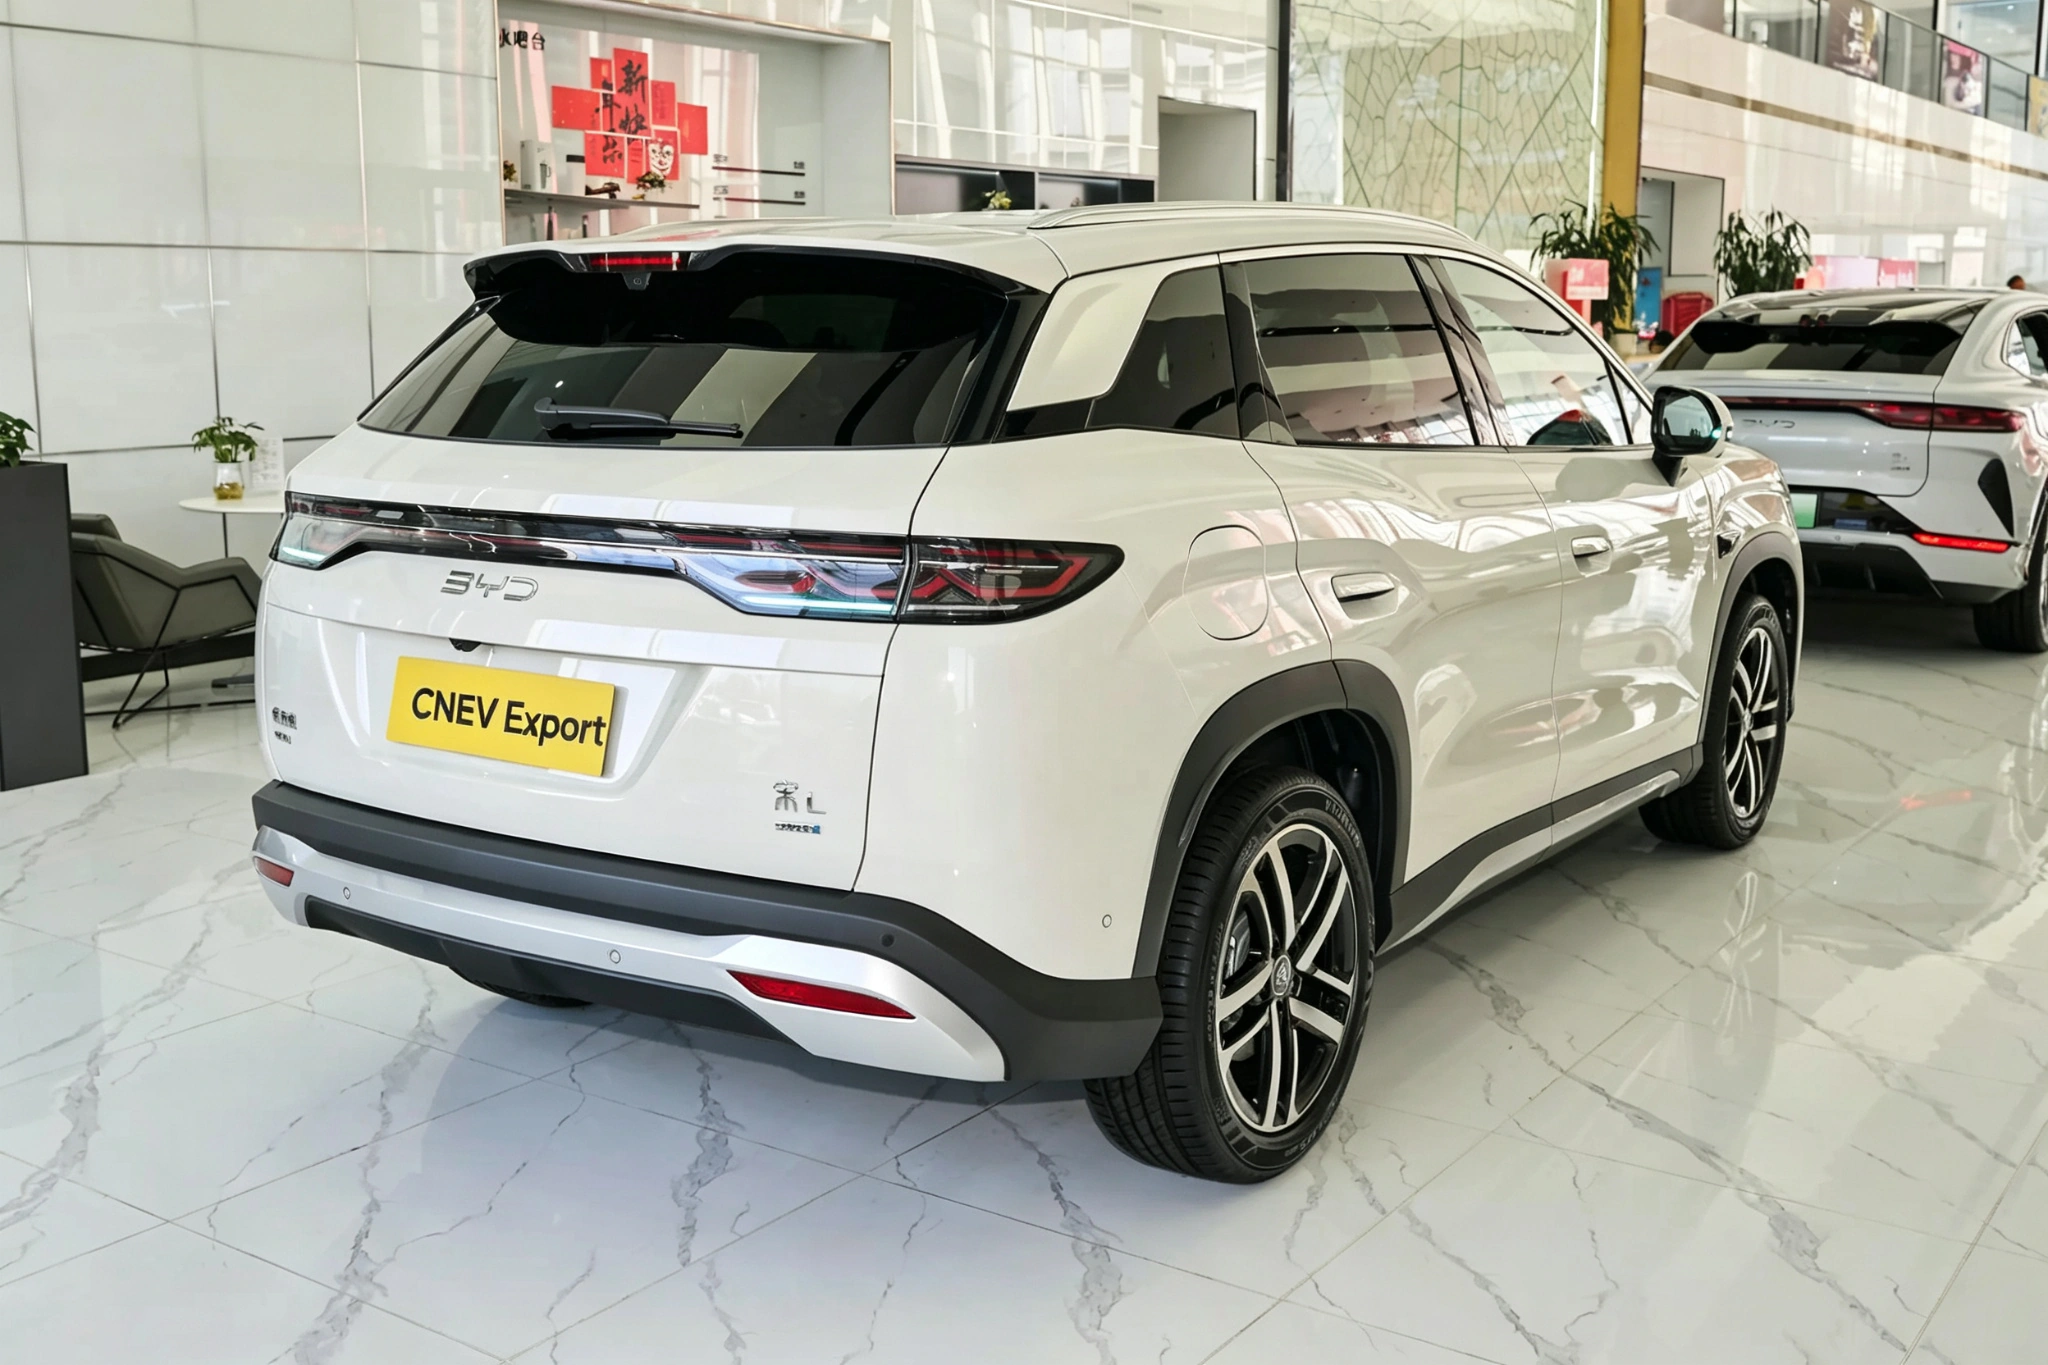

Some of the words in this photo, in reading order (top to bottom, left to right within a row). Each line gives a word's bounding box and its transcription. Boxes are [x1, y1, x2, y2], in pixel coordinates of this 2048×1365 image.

[441, 570, 539, 602] BYD
[411, 687, 500, 729] CNEV
[503, 699, 607, 747] Export
